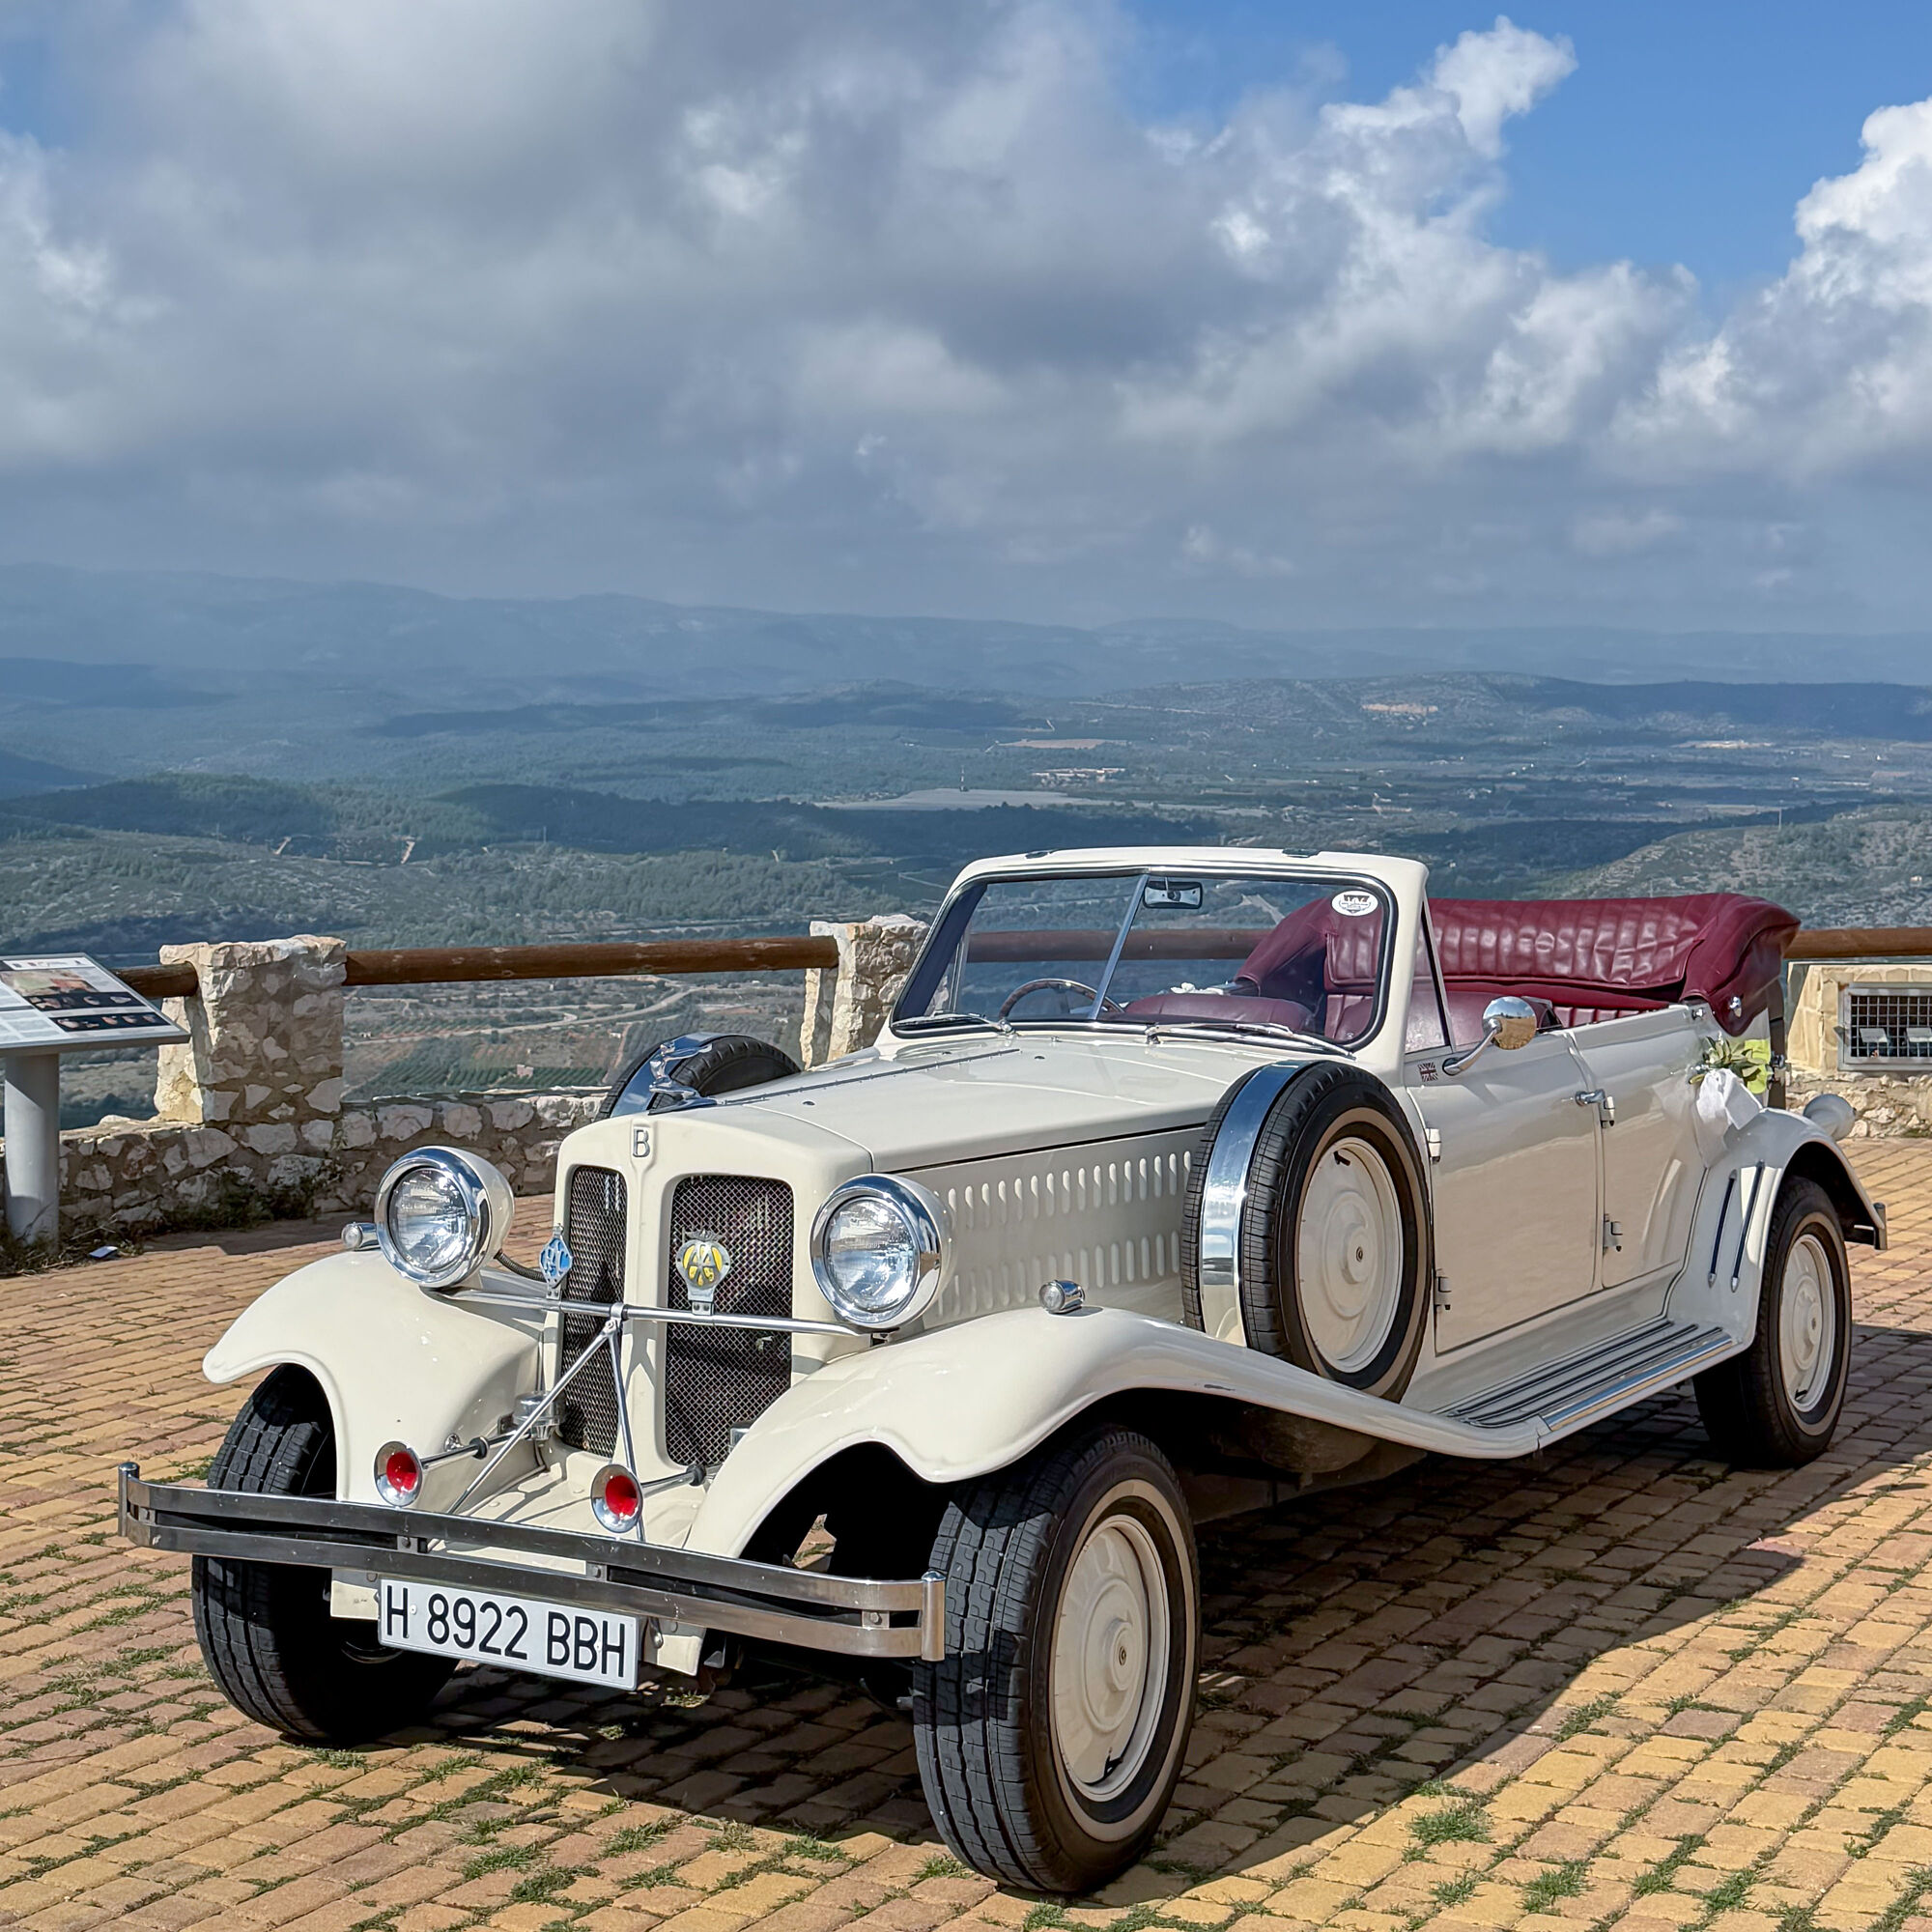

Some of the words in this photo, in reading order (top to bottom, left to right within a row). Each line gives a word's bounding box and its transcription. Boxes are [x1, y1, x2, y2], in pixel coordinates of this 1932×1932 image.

[633, 1127, 651, 1157] B
[386, 1584, 409, 1639] H
[427, 1593, 528, 1661] 8922
[546, 1610, 626, 1678] BBH
